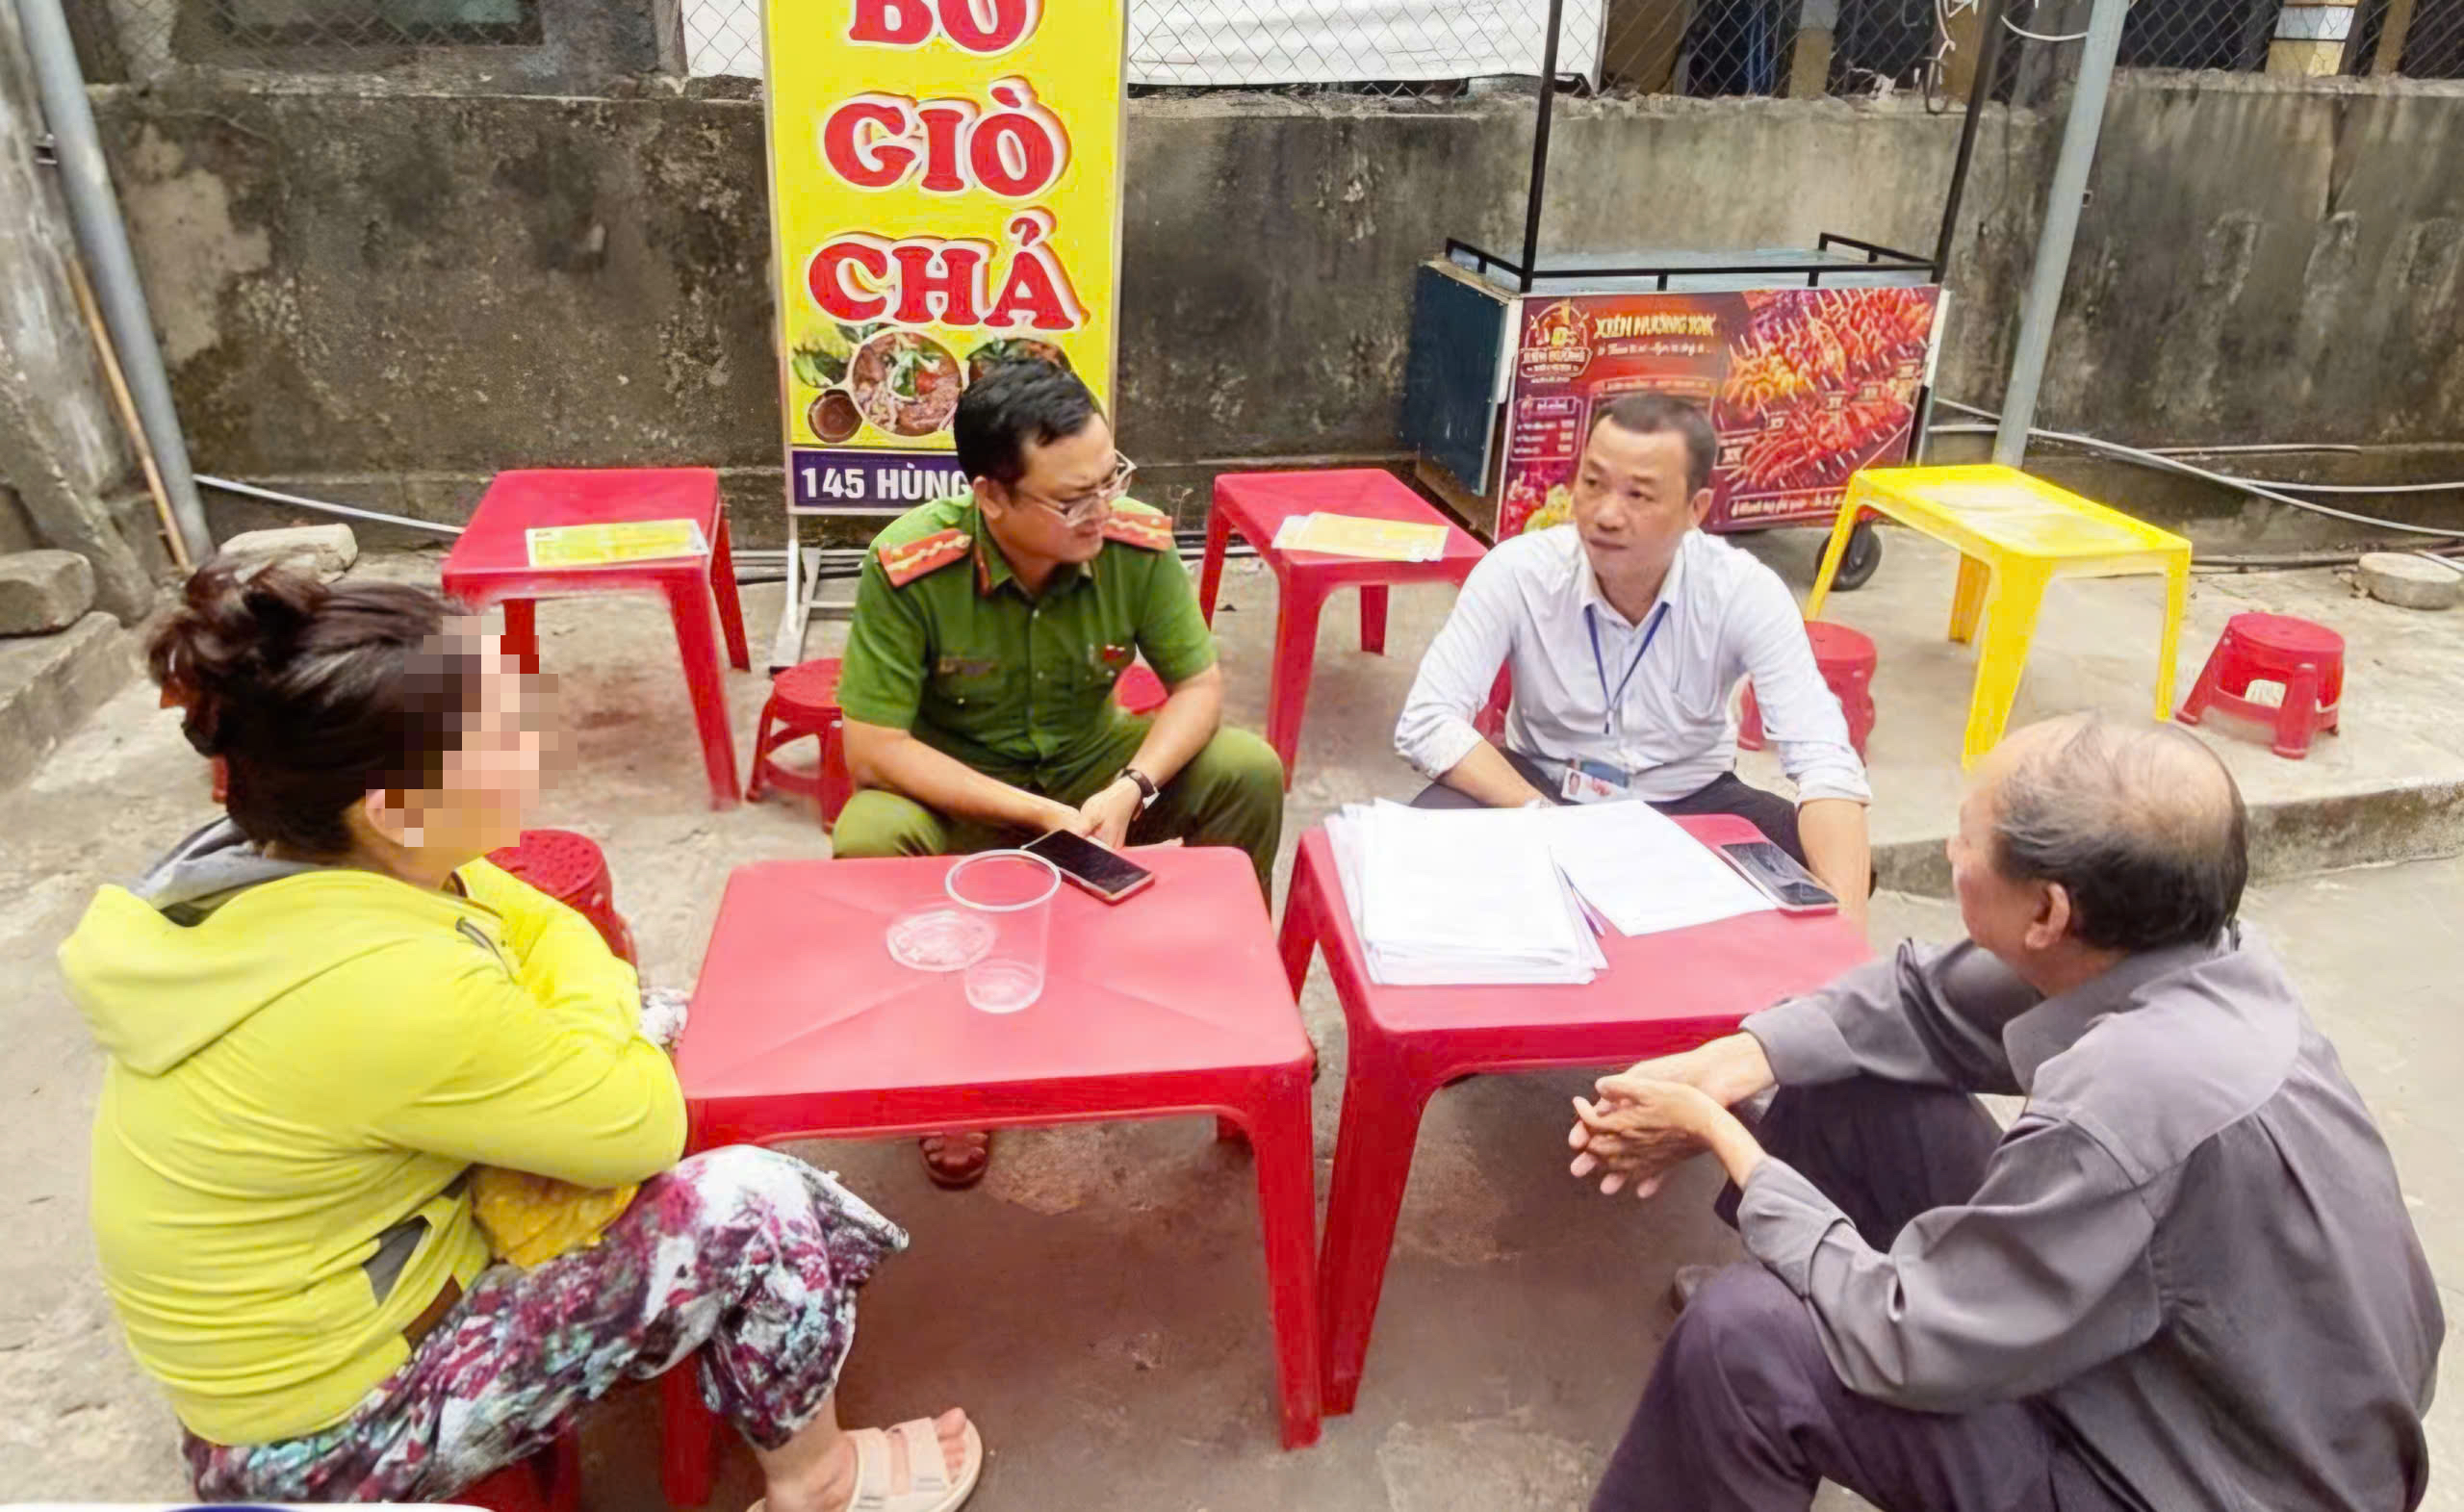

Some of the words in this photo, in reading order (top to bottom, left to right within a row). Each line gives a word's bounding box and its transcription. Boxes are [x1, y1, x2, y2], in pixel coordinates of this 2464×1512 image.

[823, 83, 1061, 198] GIÒ
[807, 214, 1082, 332] CHẢ
[801, 468, 864, 499] 145
